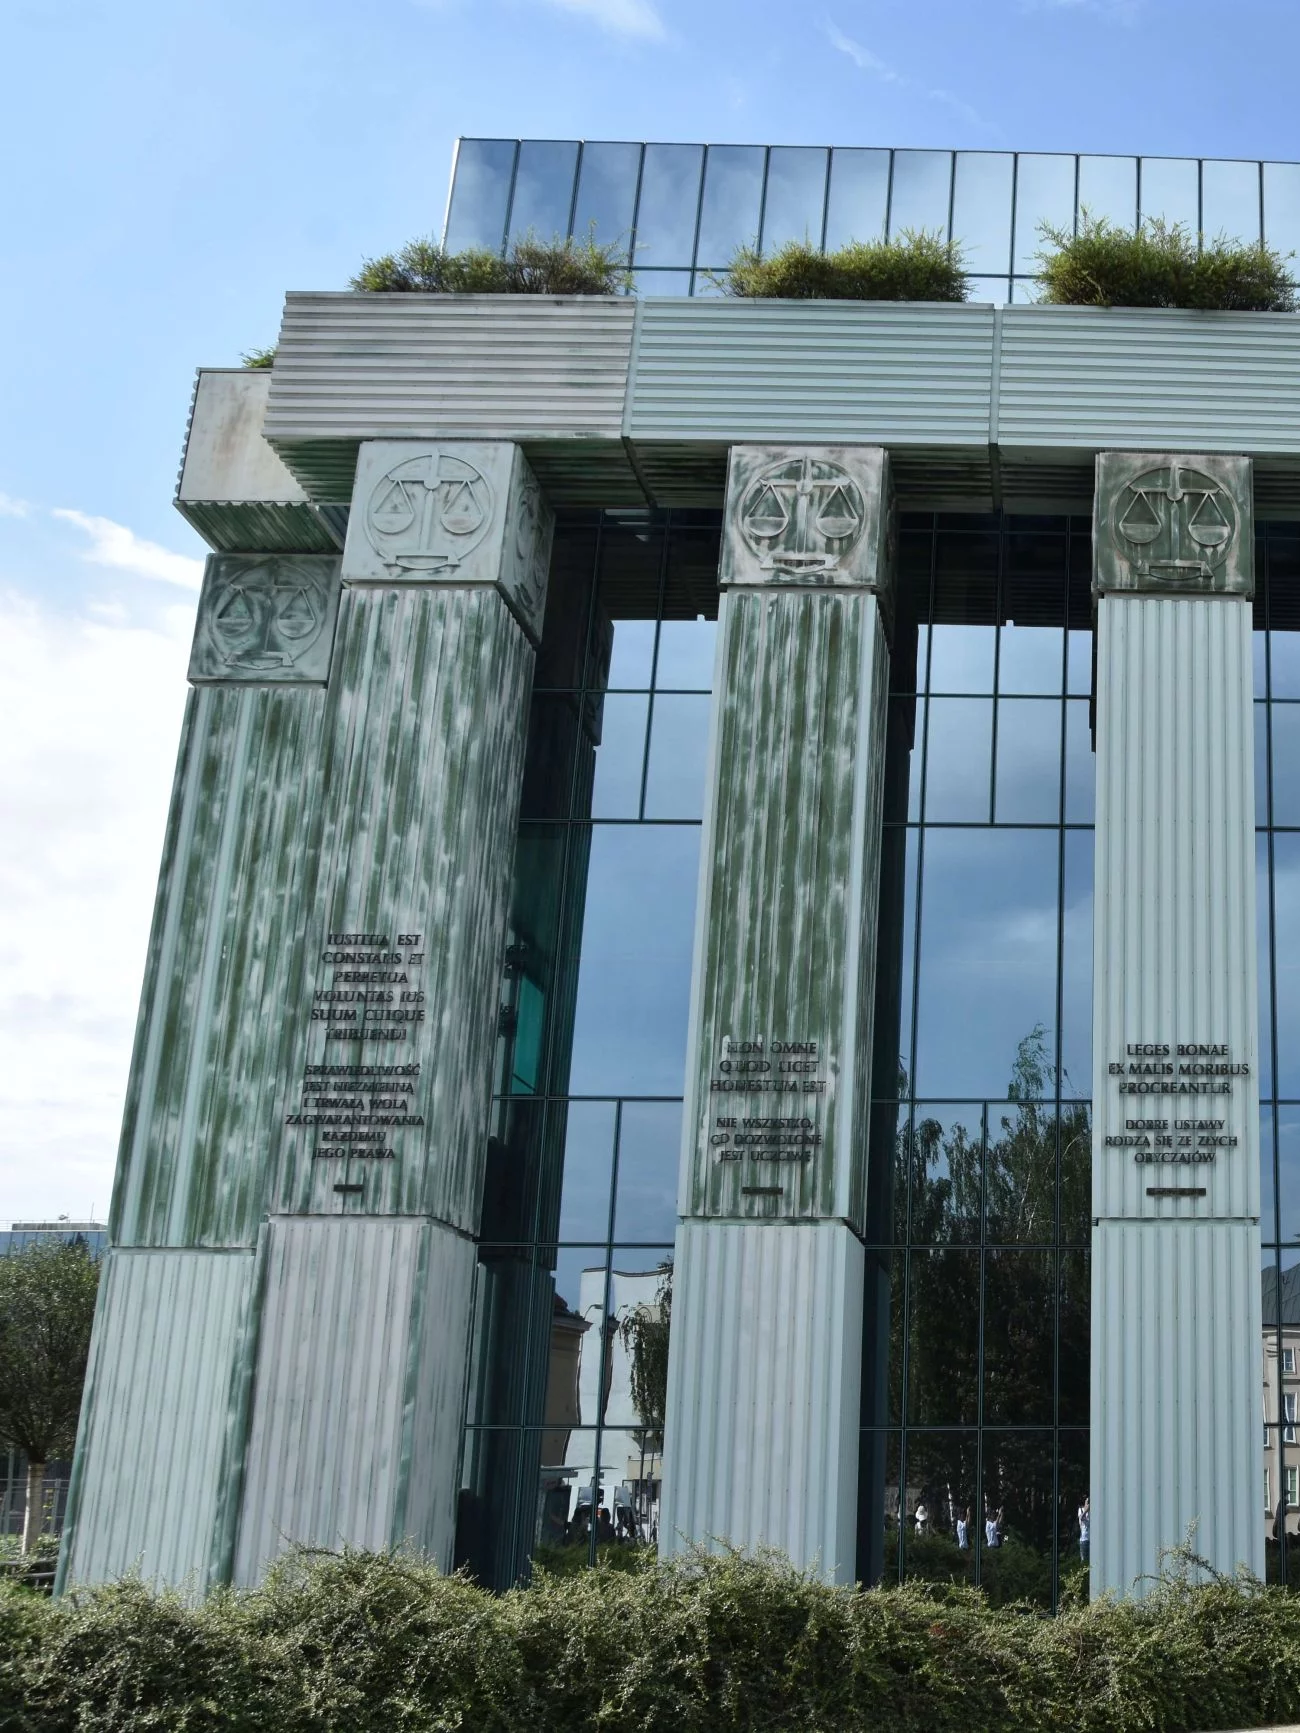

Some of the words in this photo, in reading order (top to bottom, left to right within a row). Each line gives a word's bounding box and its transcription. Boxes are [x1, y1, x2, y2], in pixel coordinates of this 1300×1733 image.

[328, 934, 389, 945] IUSTITIA
[397, 935, 421, 945] EST
[322, 952, 402, 964] CONSTANS
[408, 954, 425, 964] ET
[335, 972, 408, 983] PERPETUA
[315, 991, 394, 1002] VOLUNTAS
[401, 991, 424, 1002] IUS
[311, 1009, 356, 1021] SUUM
[365, 1010, 425, 1023] CUIQUE
[325, 1029, 407, 1040] TRIBUENDI
[727, 1042, 763, 1053] NON
[771, 1042, 817, 1053] OMNE
[1127, 1044, 1170, 1056] LEGES
[1177, 1045, 1229, 1056] BONAE
[305, 1064, 421, 1075] SPRAWIEDLIWOŚĆ
[720, 1061, 771, 1075] QUOD
[779, 1061, 819, 1072] LICET
[1109, 1063, 1125, 1075] EX
[1129, 1063, 1173, 1075] MALIS
[1179, 1064, 1249, 1075] MORIBUS
[303, 1082, 330, 1093] JEST
[711, 1080, 798, 1092] HONESTUM
[803, 1081, 826, 1092] EST
[1119, 1082, 1231, 1094] PROCREANTUR
[304, 1098, 308, 1107] I
[369, 1099, 408, 1111] WOLĄ
[285, 1115, 424, 1125] ZAGWARANTOWANIA
[717, 1118, 737, 1127] NIE
[1126, 1120, 1168, 1130] DOBRE
[1174, 1120, 1225, 1130] USTAWY
[710, 1134, 730, 1145] CO
[734, 1135, 822, 1144] DOZWOLONE
[1105, 1136, 1150, 1148] RODZĄ
[1155, 1136, 1173, 1148] SIĘ
[1178, 1136, 1192, 1146] ZE
[1198, 1136, 1238, 1146] ZŁYCH
[312, 1148, 345, 1159] JEGO
[350, 1149, 396, 1159] PRAWA
[720, 1151, 745, 1162] JEST
[751, 1151, 811, 1162] UCZCIWE
[1135, 1151, 1216, 1164] OBYCZAJÓW
